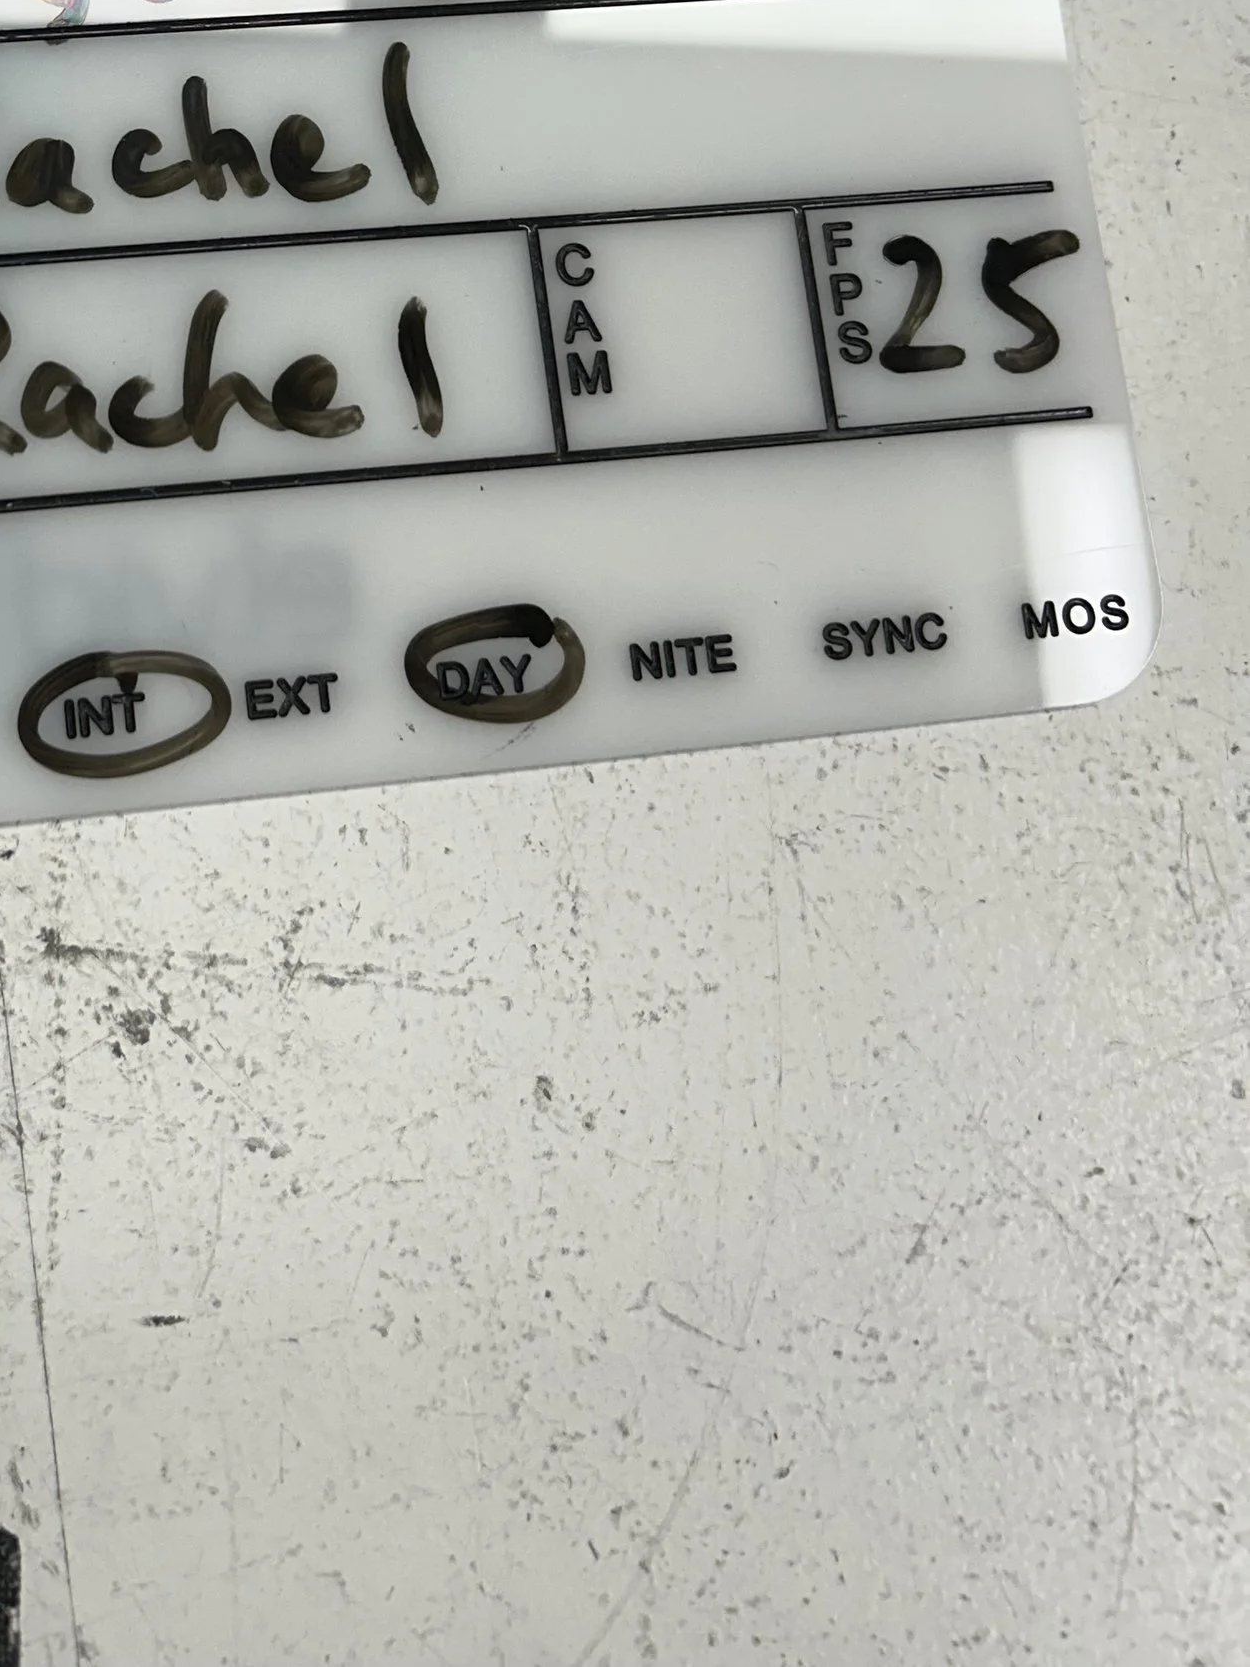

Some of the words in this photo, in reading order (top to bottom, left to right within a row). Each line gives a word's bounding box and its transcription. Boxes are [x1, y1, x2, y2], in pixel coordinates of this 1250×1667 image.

[821, 220, 874, 366] FPS
[878, 229, 1081, 374] 25
[555, 242, 613, 397] CAM
[822, 612, 949, 661] SYNC
[1020, 594, 1131, 641] MOS
[435, 651, 532, 701] DAY
[628, 633, 738, 681] NITE
[62, 690, 145, 741] INT
[243, 671, 339, 721] EXT
